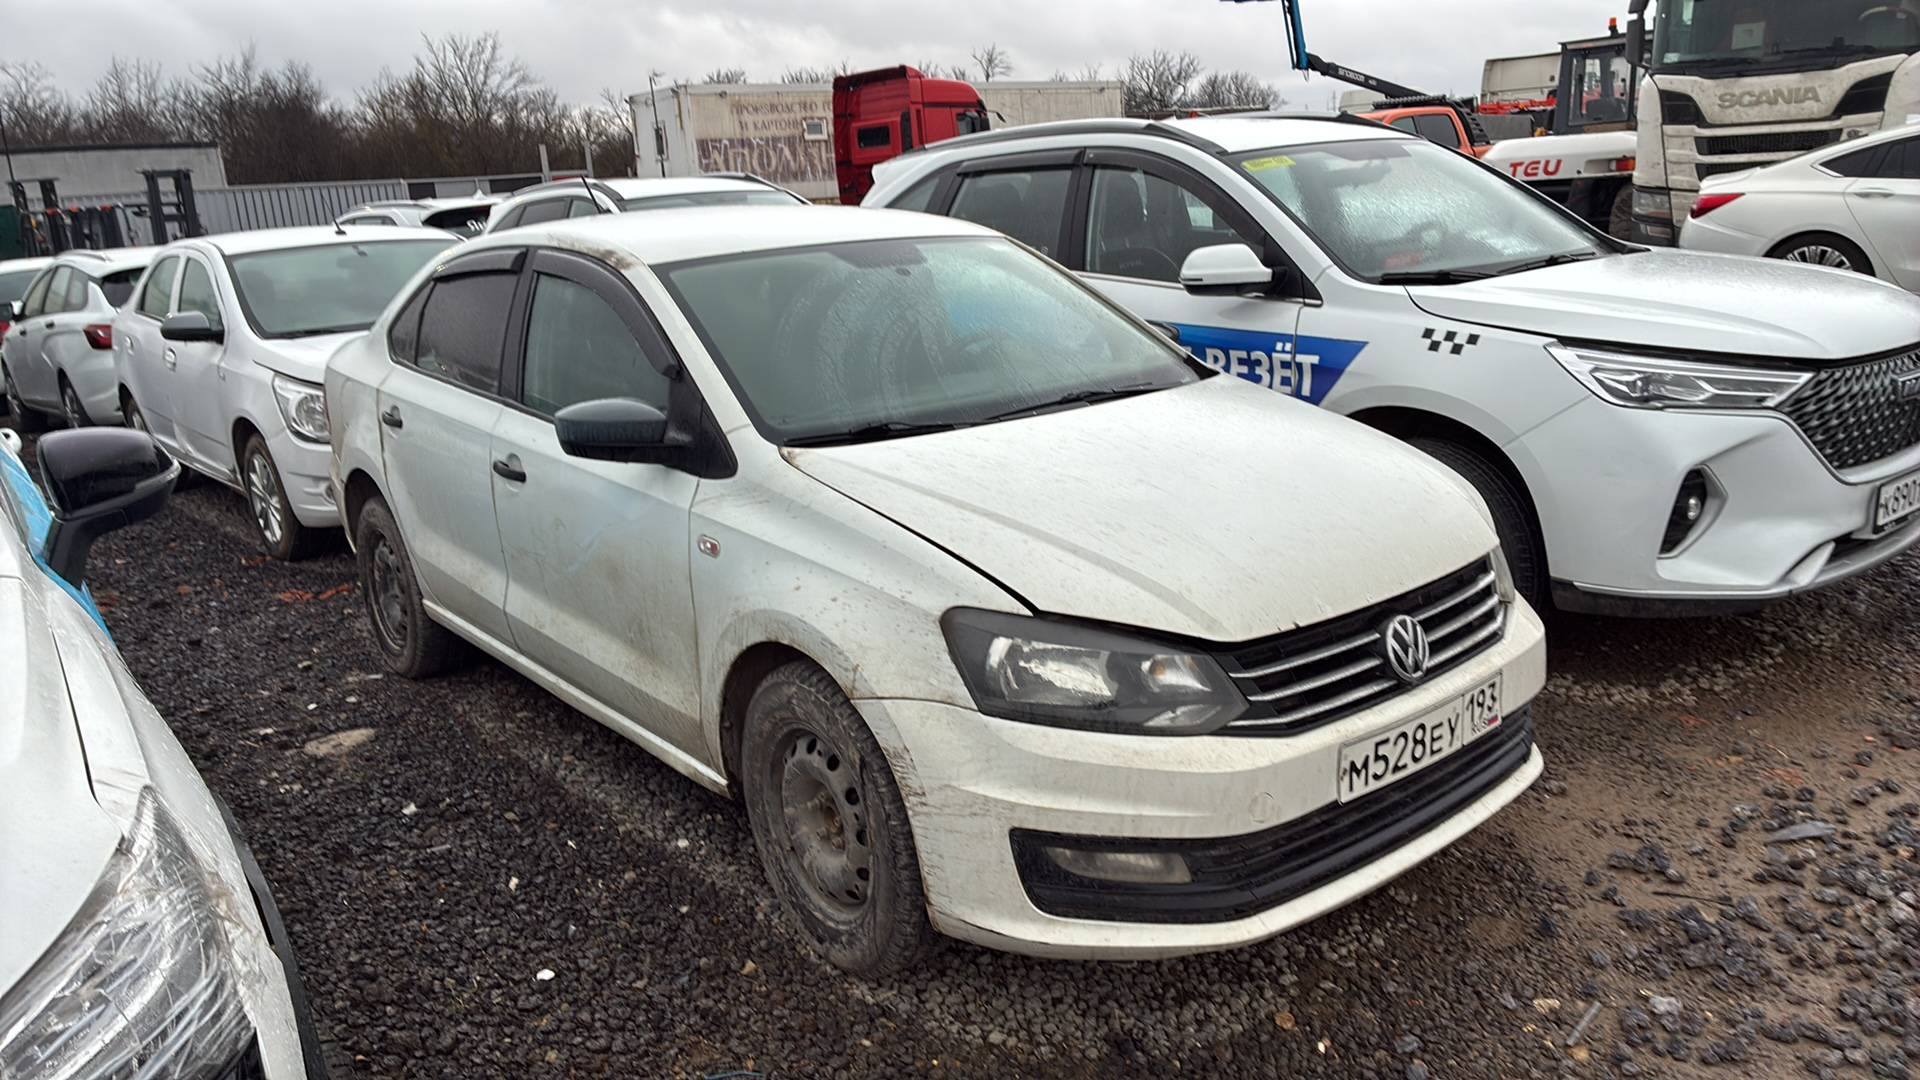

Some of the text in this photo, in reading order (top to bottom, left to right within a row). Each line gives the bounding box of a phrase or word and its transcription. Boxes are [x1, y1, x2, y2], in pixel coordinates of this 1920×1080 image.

[1717, 86, 1822, 109] SCANIA
[1509, 159, 1563, 178] TEU
[1466, 681, 1497, 724] 193
